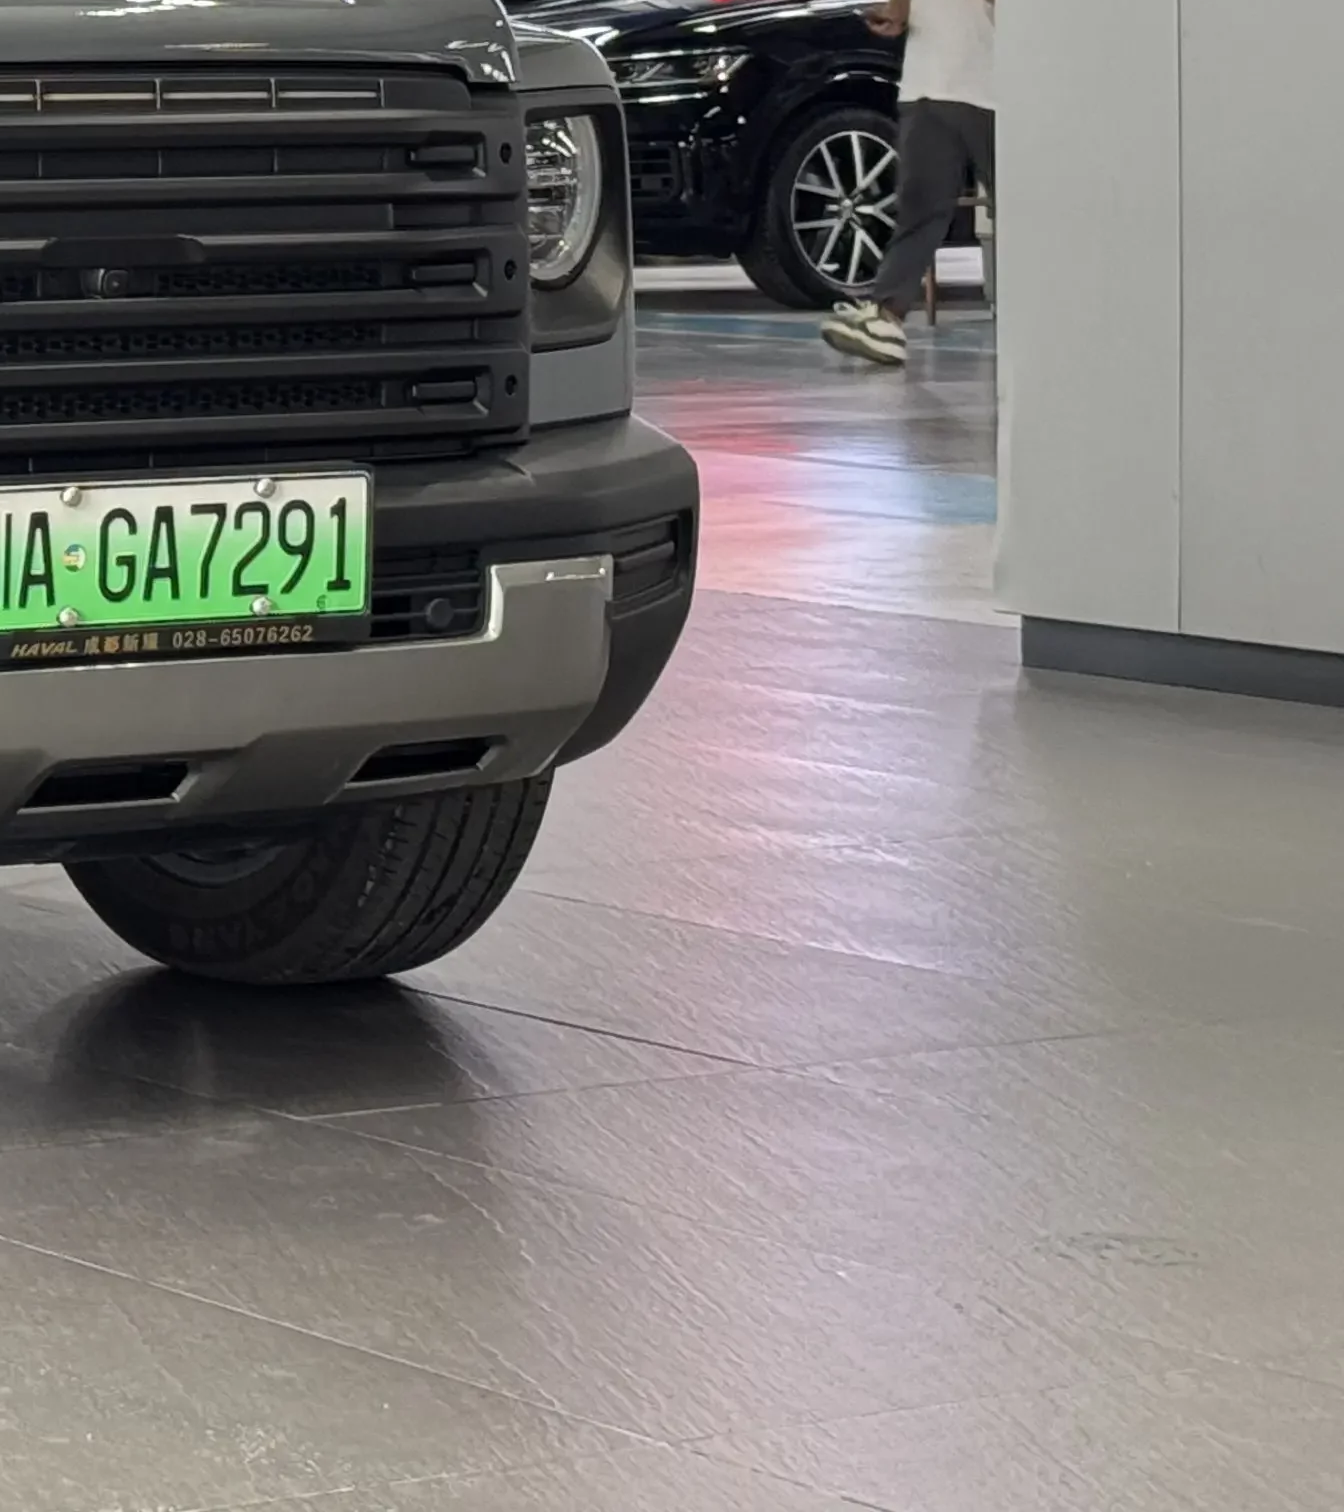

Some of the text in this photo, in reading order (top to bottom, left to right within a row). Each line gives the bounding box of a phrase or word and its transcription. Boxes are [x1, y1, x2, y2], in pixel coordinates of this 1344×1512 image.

[97, 496, 353, 604] GA7291
[10, 640, 79, 658] HAVAL
[172, 624, 314, 649] 028-65076262
